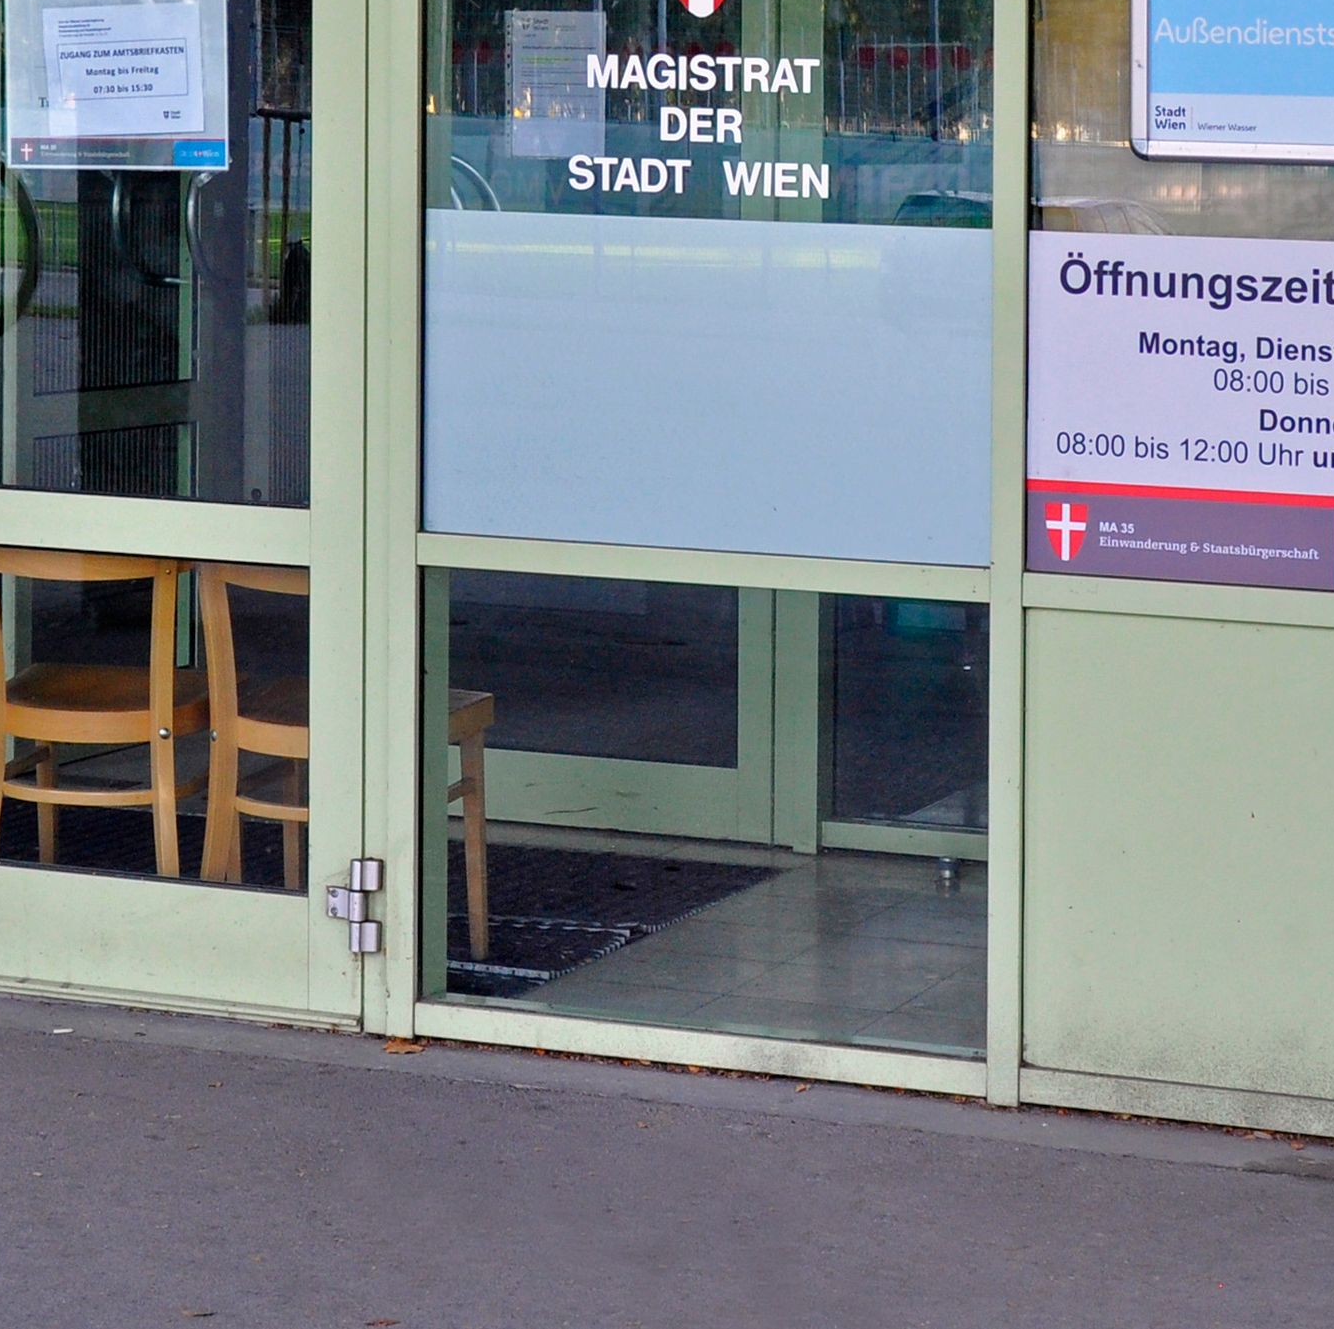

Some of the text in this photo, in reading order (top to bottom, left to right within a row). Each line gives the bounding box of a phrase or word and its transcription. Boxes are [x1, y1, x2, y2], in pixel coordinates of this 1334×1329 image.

[59, 46, 184, 60] ZUGANG ZUM AMTSBRIEFKASTEN
[86, 66, 159, 77] Montag bis Freitag
[587, 54, 820, 94] MAGISTRAT
[117, 85, 129, 93] bis
[1155, 105, 1186, 118] Stadt
[660, 107, 742, 144] DER
[1155, 118, 1257, 133] Wien Wiener Wasser
[569, 154, 830, 200] STADT WIEN
[1138, 332, 1247, 365] Montag,
[1213, 369, 1285, 396] 08:00
[1294, 371, 1330, 398] bis
[1056, 431, 1125, 458] 08:00
[1133, 434, 1170, 461] bis
[1180, 438, 1249, 464] 12:00
[1257, 441, 1304, 468] Uhr
[1099, 521, 1135, 535] MA 35
[1099, 536, 1319, 561] Einwanderung & Staatsbürgerschaft
